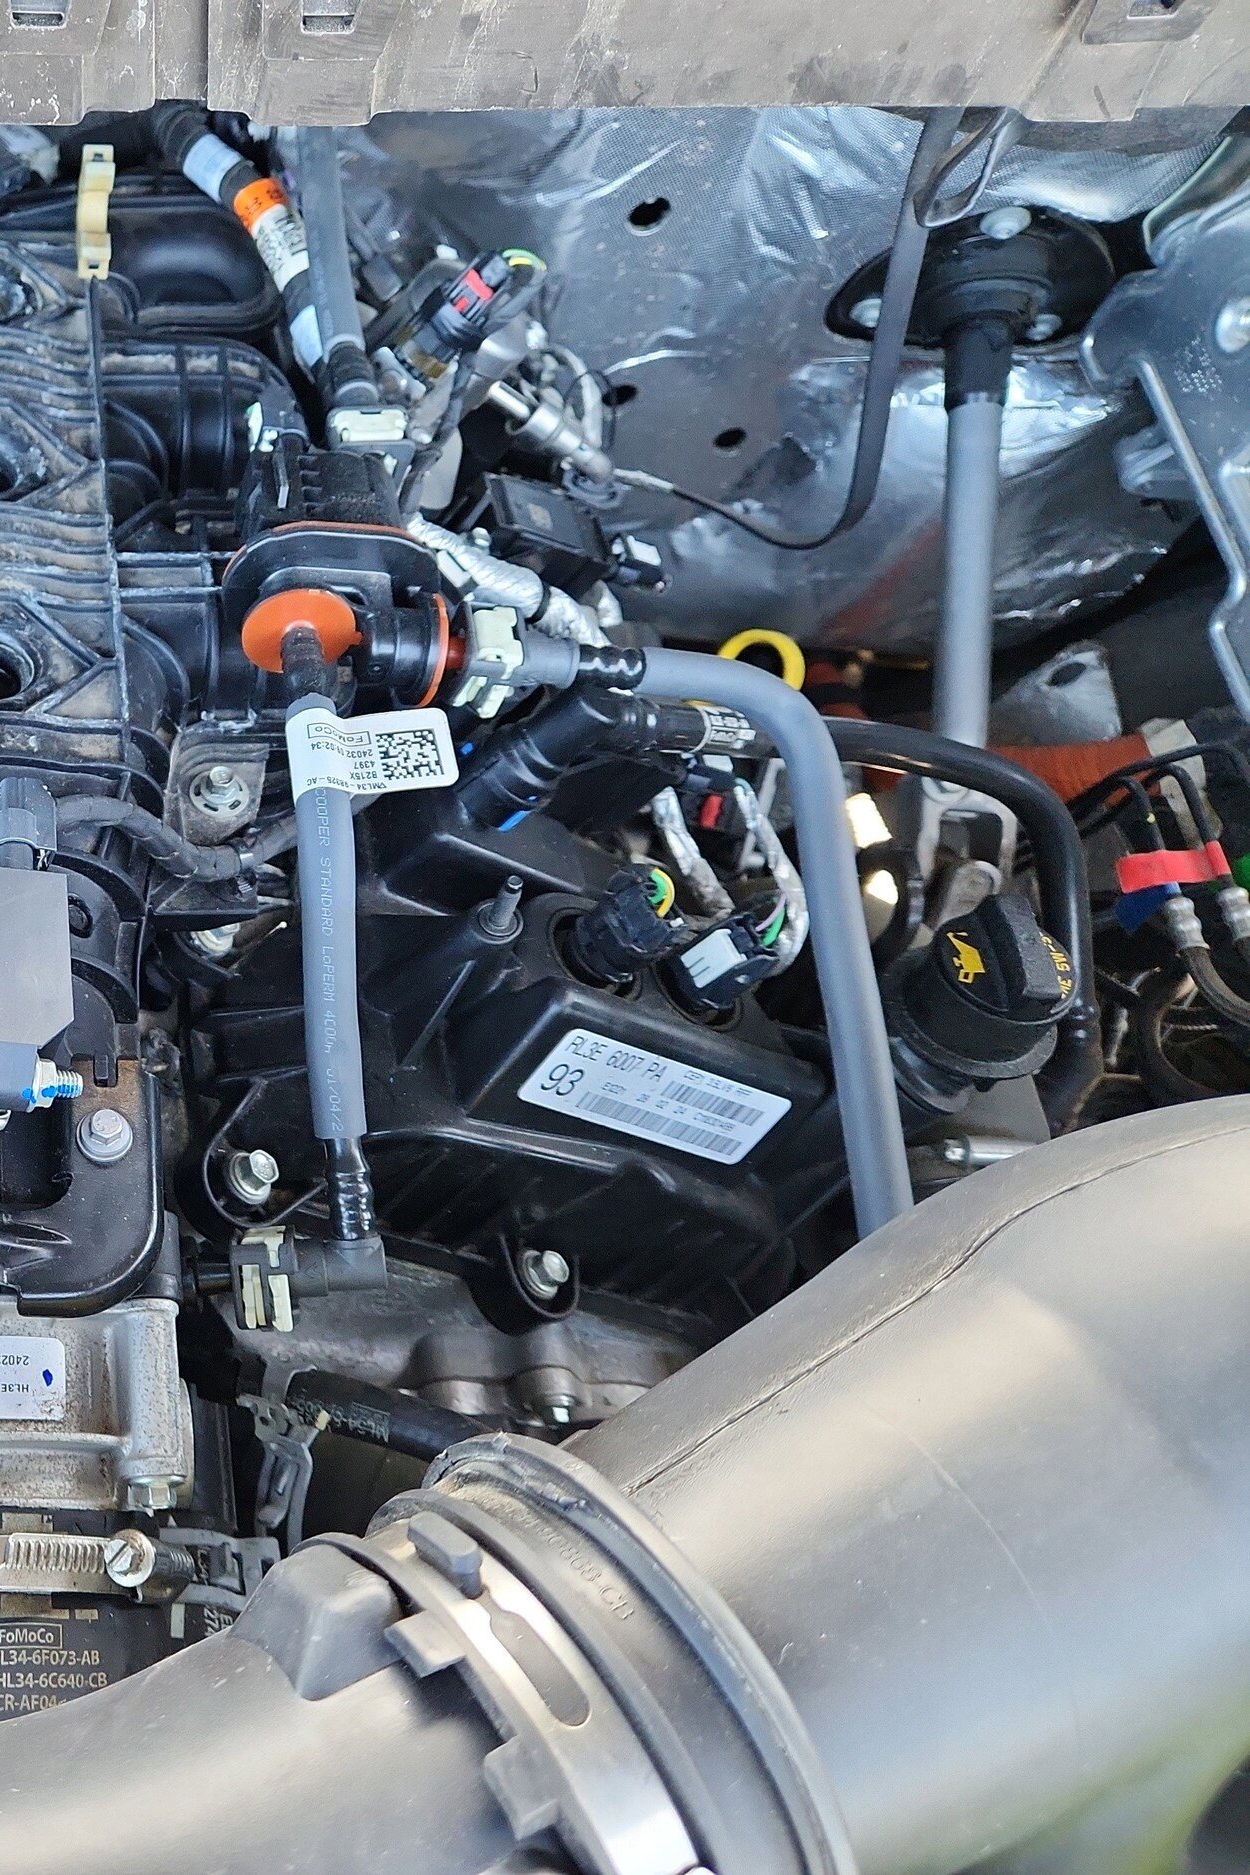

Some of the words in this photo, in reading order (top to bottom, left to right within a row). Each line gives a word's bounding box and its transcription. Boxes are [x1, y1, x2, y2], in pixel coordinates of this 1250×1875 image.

[314, 725, 363, 743] FoMoCo
[346, 748, 372, 757] 24032
[353, 759, 375, 768] 4397
[314, 786, 331, 847] COOPER
[315, 856, 336, 937] STANDARD
[319, 944, 337, 1001] LoPERM
[565, 1035, 608, 1062] RL3E
[605, 1049, 645, 1073] 6007
[645, 1061, 668, 1082] PA
[540, 1063, 585, 1097] 93
